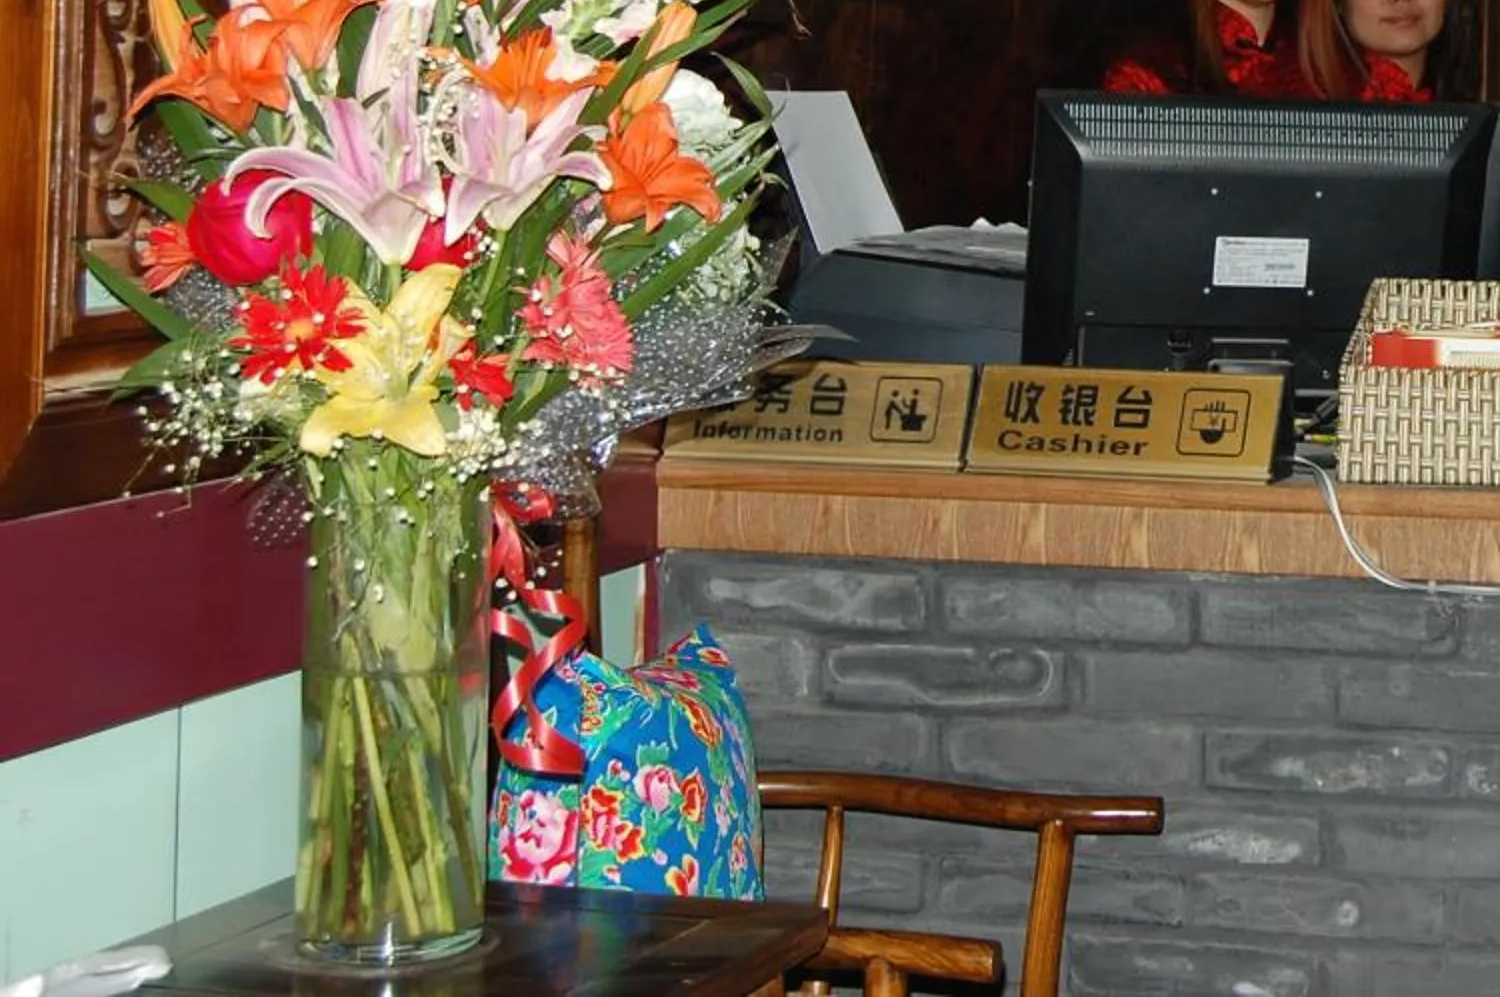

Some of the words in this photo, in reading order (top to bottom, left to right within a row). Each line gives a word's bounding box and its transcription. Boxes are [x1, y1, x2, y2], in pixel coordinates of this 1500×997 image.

[701, 373, 848, 415] 务台
[1004, 380, 1153, 428] 收银台
[693, 419, 843, 443] Information
[997, 429, 1149, 456] Cashier
